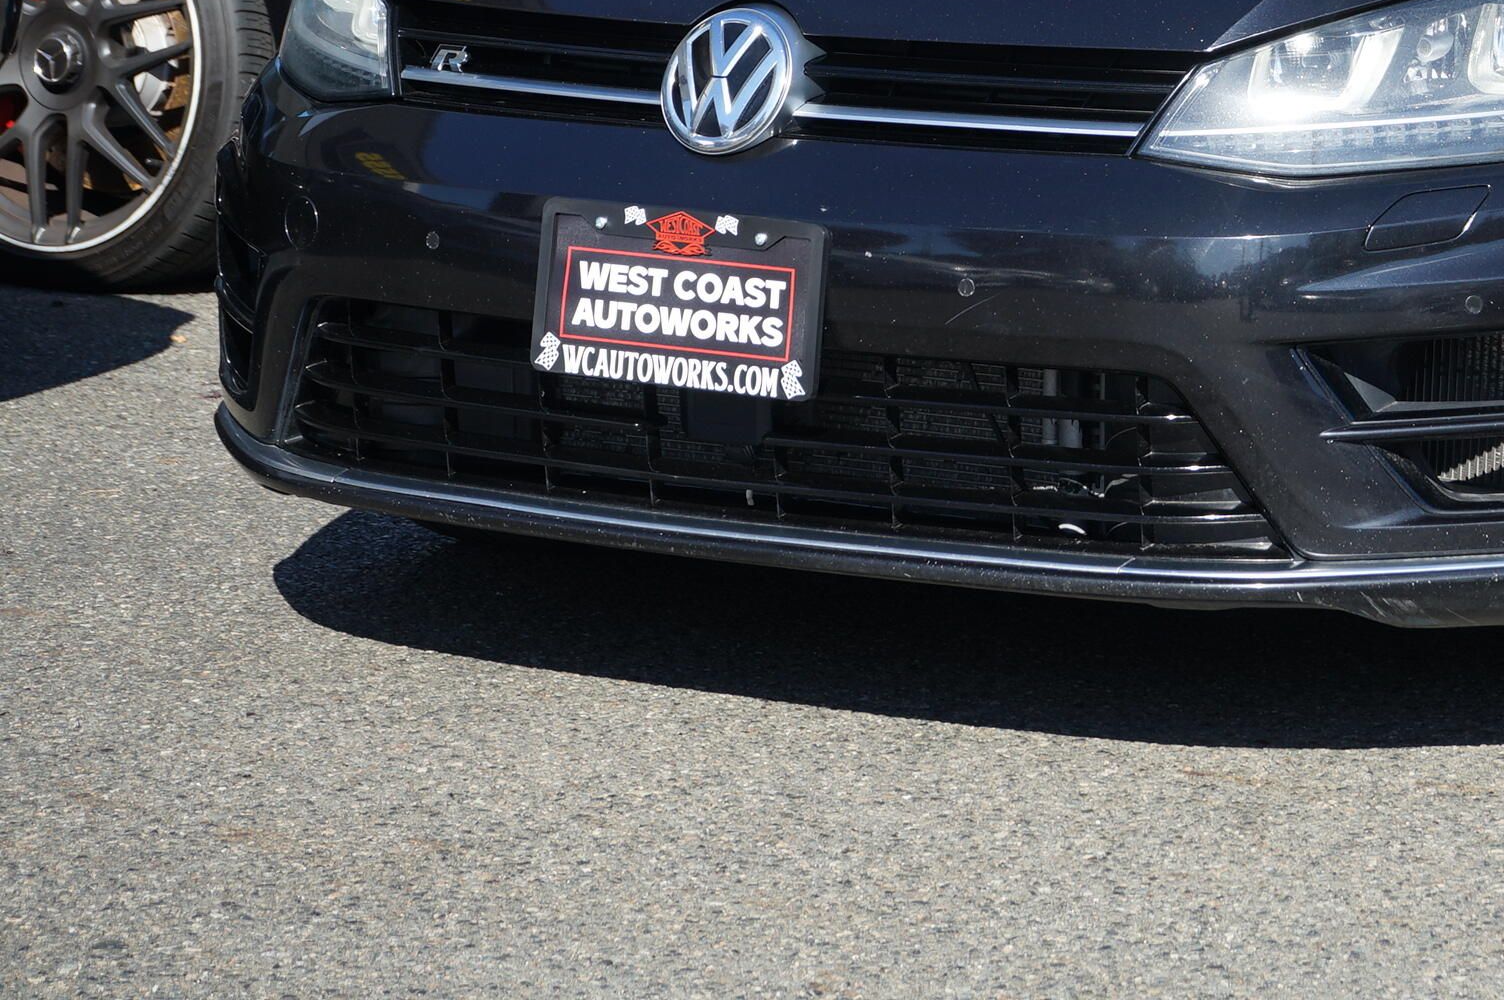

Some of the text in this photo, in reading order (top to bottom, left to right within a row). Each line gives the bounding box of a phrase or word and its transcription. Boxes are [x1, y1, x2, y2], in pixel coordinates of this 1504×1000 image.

[579, 260, 787, 309] WEST COAST
[571, 297, 783, 348] AUTOWORKS
[562, 343, 781, 398] WCAUTOWORKS.COM
